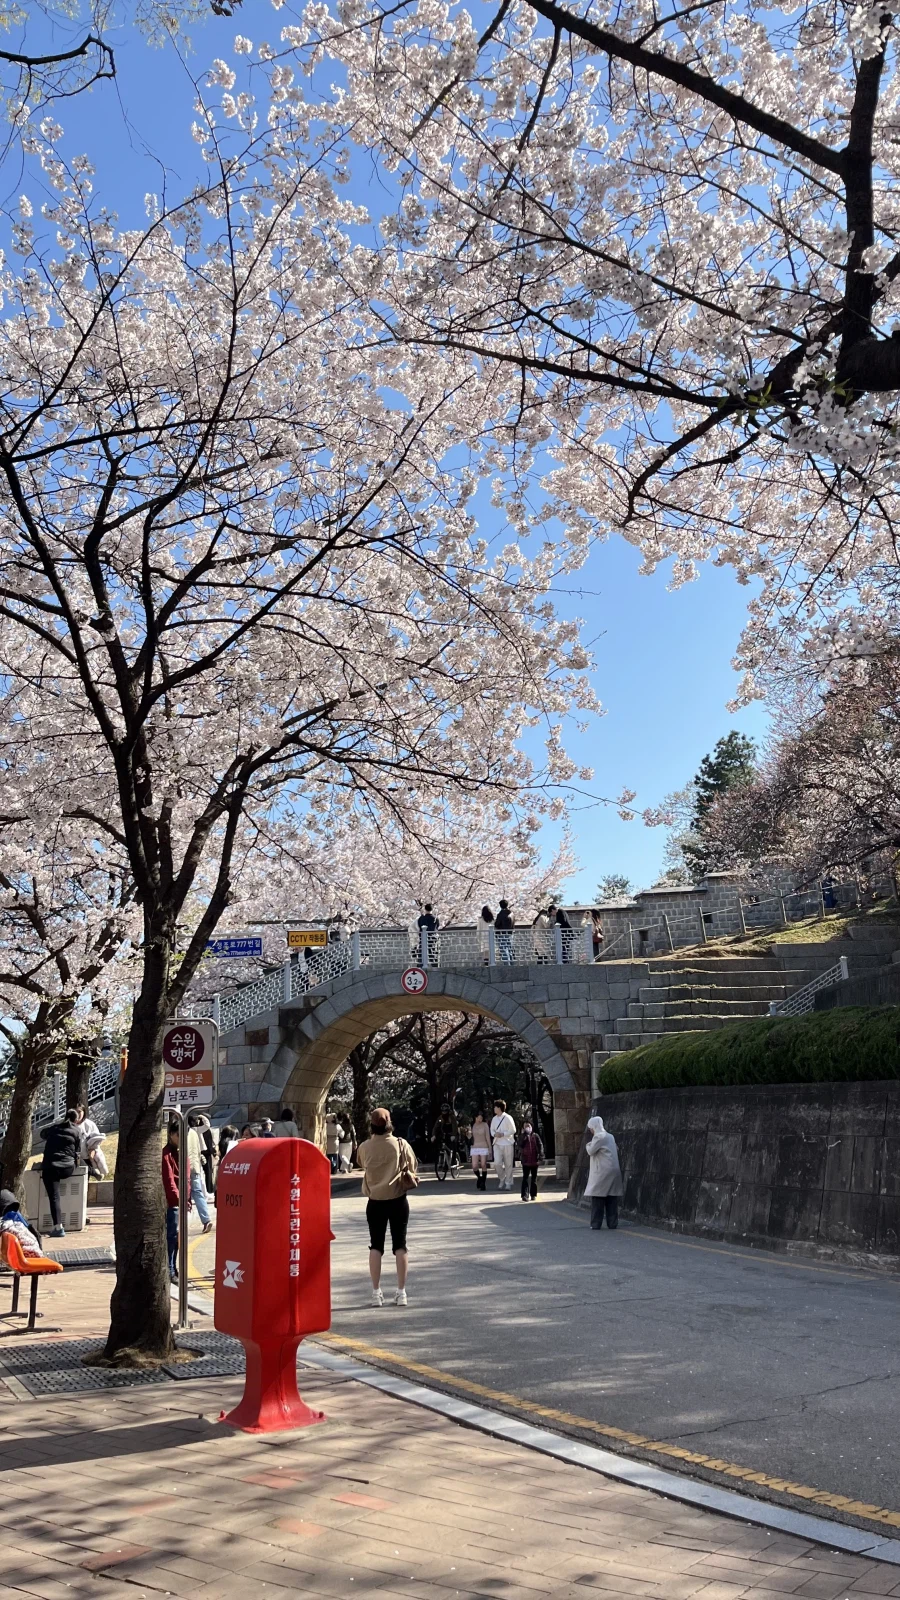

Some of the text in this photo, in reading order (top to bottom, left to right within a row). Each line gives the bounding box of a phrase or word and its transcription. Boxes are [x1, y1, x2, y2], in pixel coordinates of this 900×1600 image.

[290, 935, 307, 943] CCTV
[171, 1033, 196, 1048] 수원
[176, 1073, 203, 1085] 타는 곳
[168, 1089, 198, 1102] 남포루
[225, 1193, 244, 1208] POST
